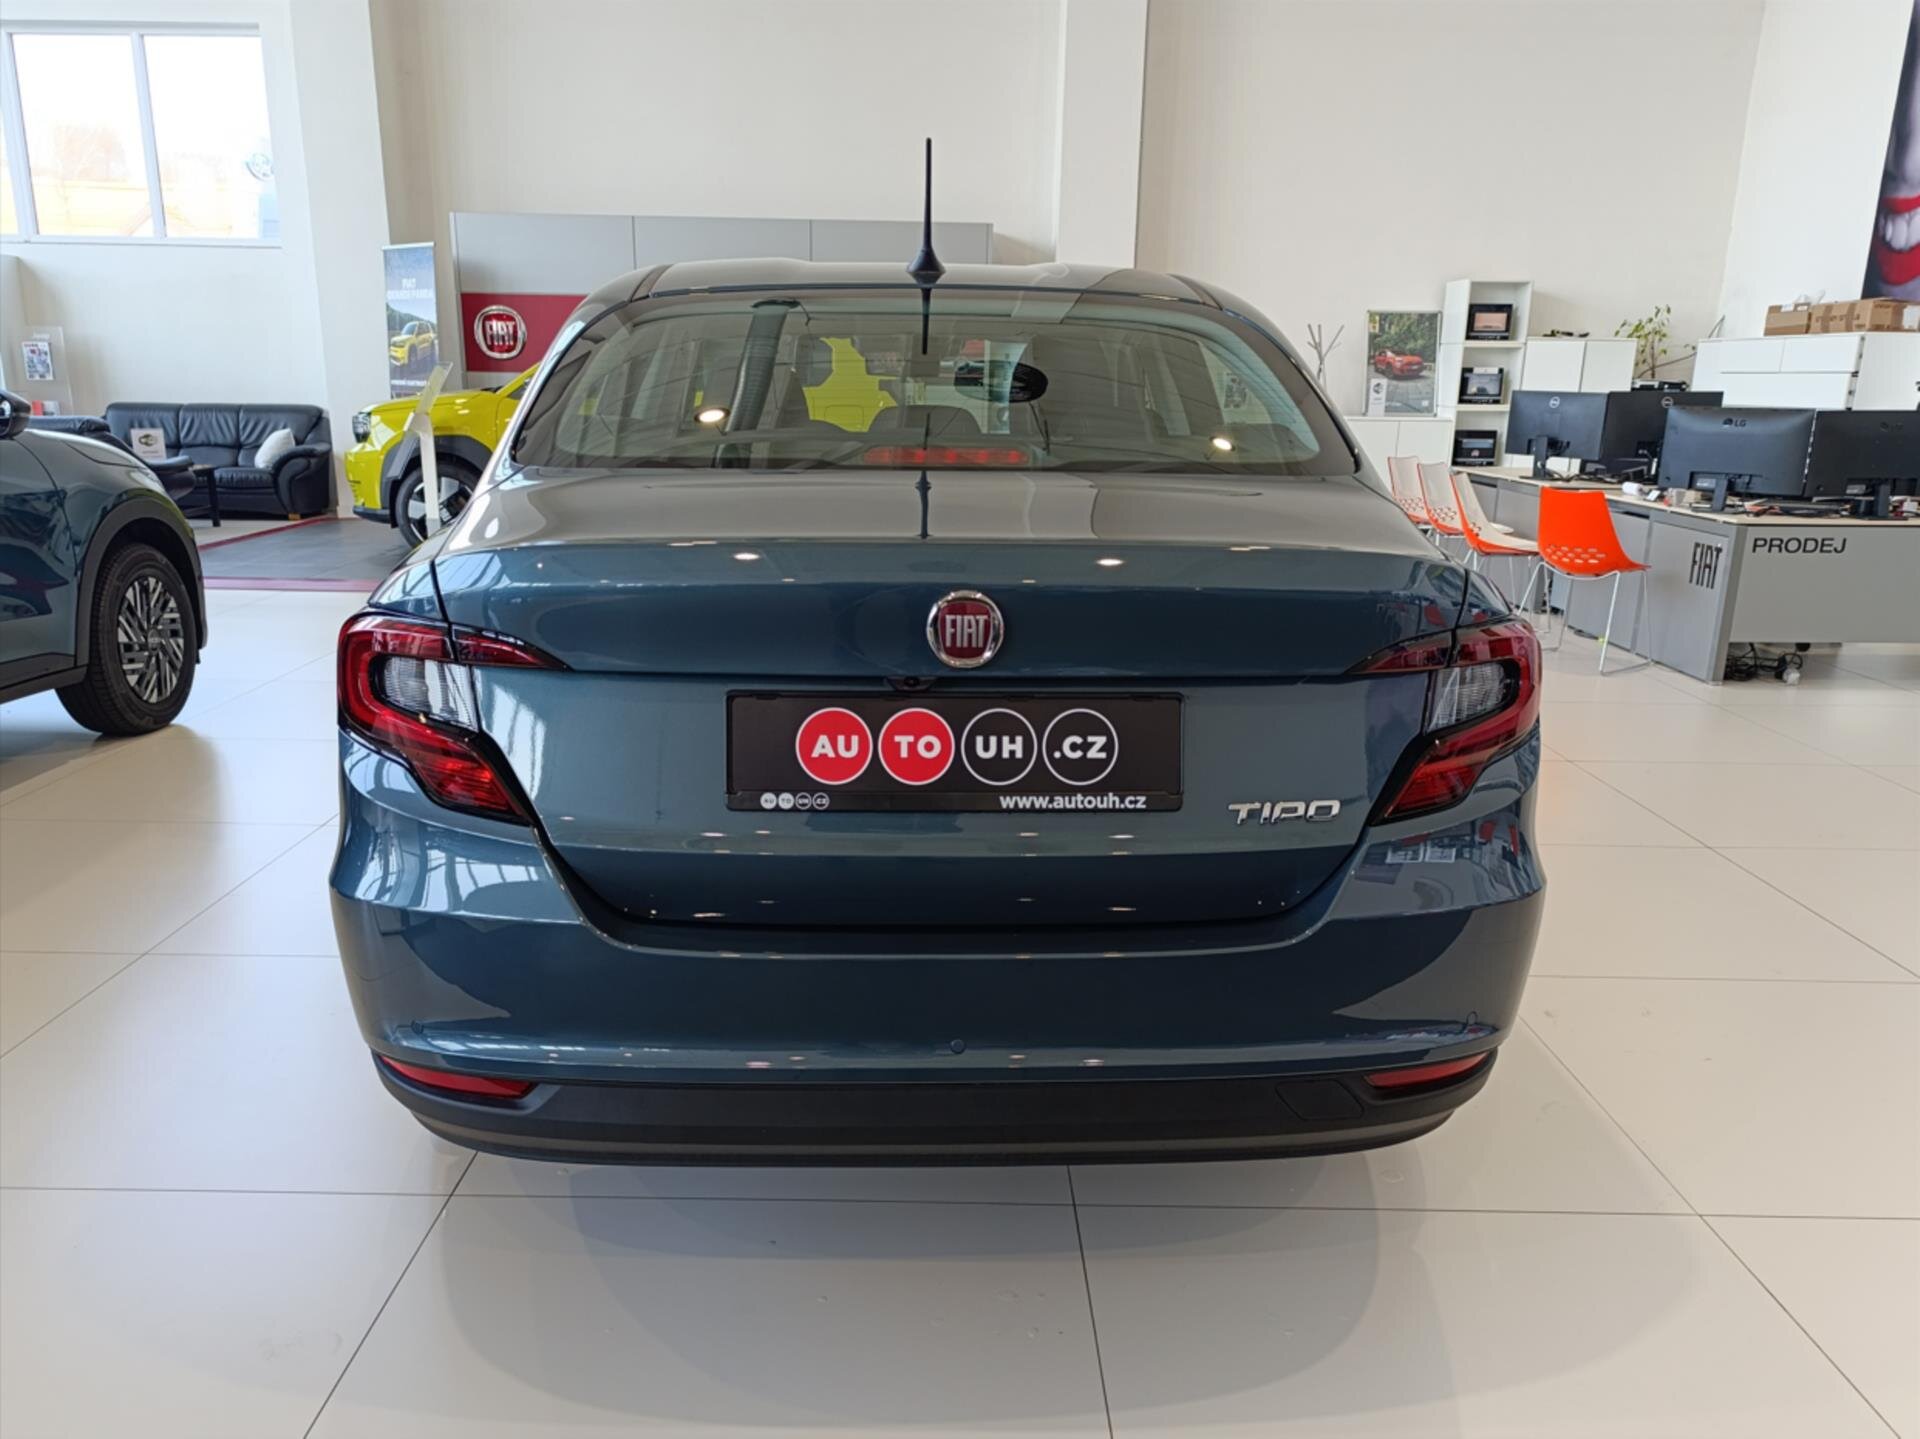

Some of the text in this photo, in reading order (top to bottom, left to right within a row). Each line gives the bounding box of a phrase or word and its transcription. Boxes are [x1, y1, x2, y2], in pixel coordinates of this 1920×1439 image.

[484, 319, 515, 346] FIAT
[1734, 419, 1747, 427] LG
[1752, 537, 1847, 554] PRODEJ
[1689, 541, 1723, 589] FIAT
[945, 614, 989, 648] FIAT
[810, 735, 1107, 759] AU TO UH .CZ
[1000, 792, 1147, 809] www.autouh.cz
[1228, 799, 1341, 825] TIPO
